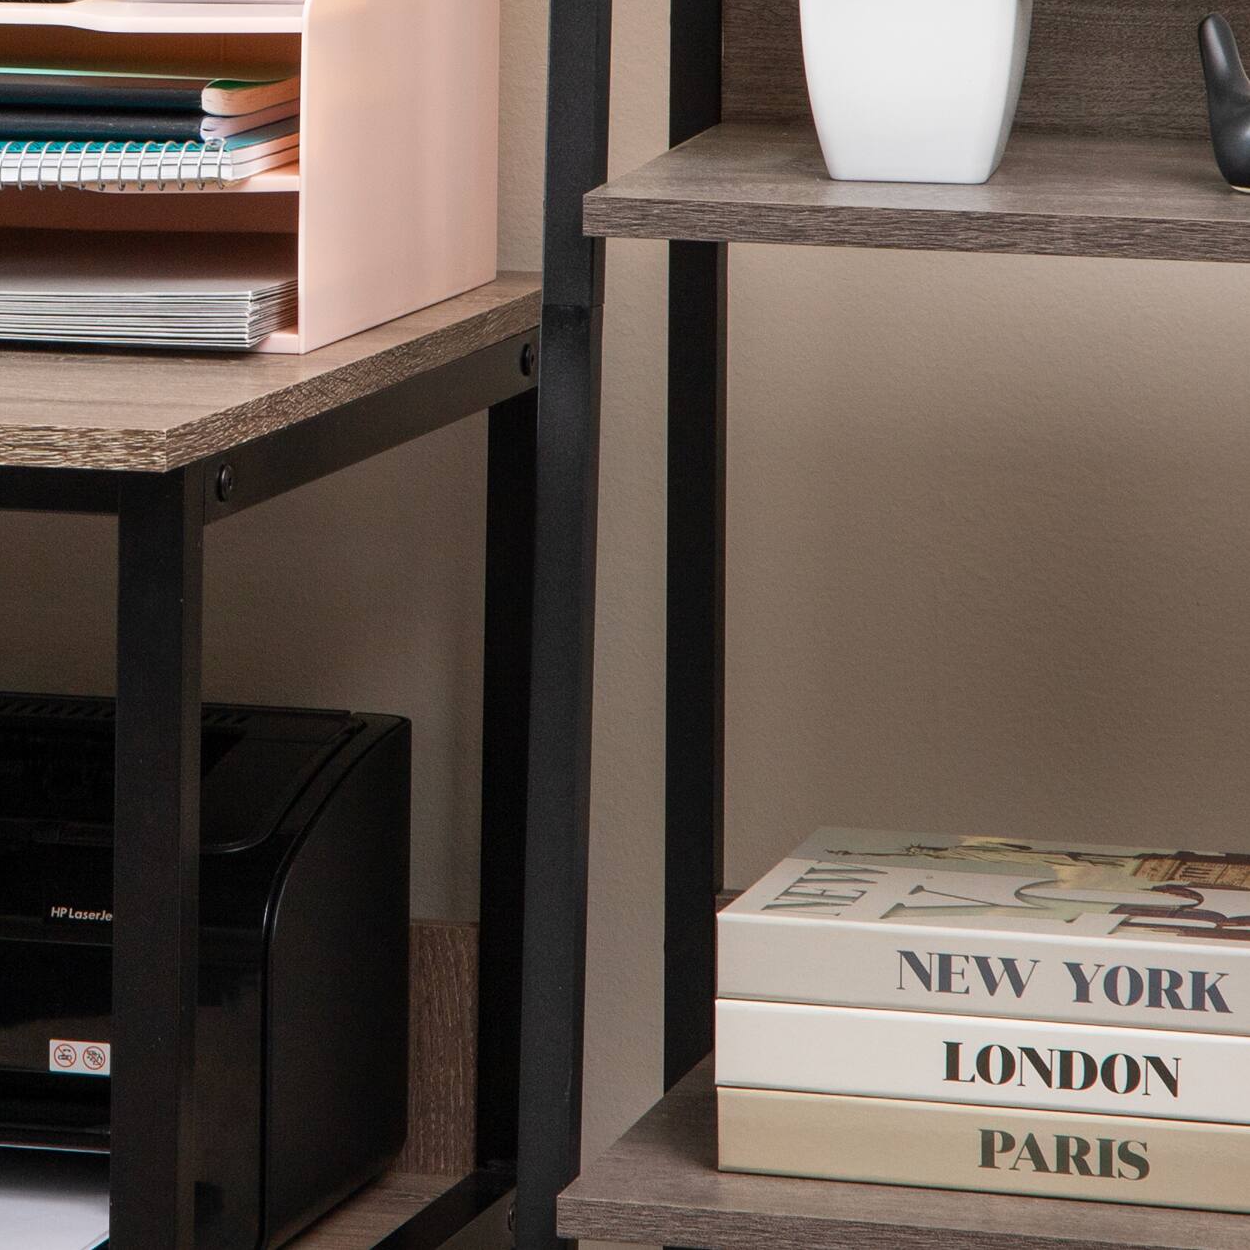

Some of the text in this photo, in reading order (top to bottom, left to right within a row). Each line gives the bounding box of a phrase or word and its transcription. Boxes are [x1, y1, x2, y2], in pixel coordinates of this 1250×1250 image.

[51, 906, 67, 918] HP
[896, 949, 1234, 1014] NEW YORK
[942, 1040, 1182, 1099] LONDON
[977, 1127, 1151, 1181] PARIS
